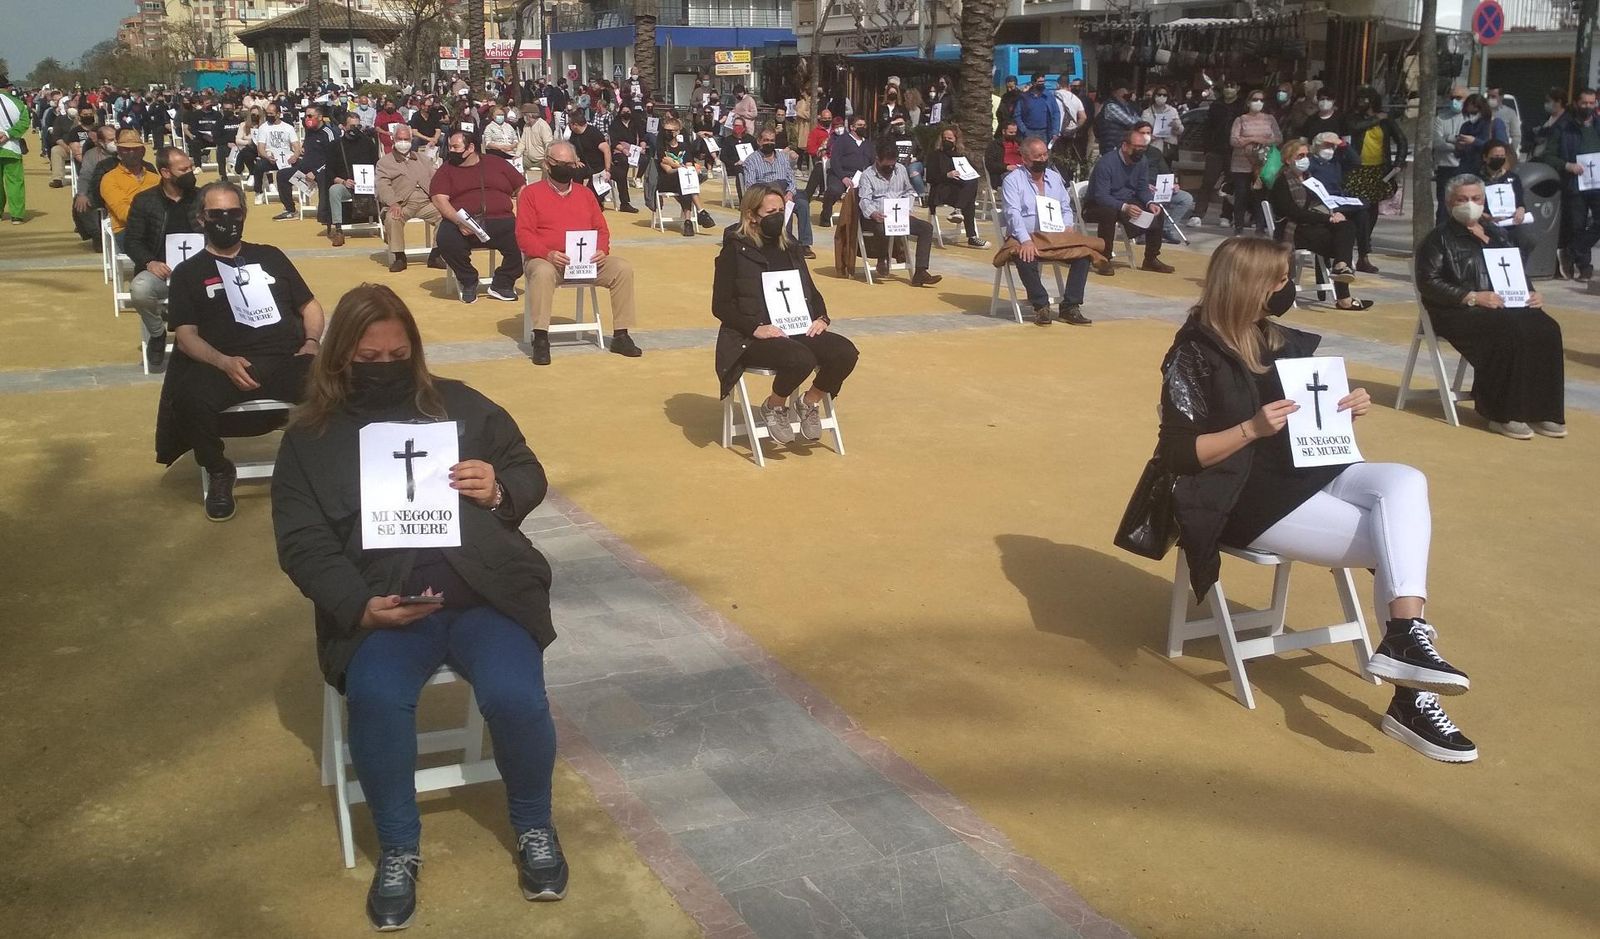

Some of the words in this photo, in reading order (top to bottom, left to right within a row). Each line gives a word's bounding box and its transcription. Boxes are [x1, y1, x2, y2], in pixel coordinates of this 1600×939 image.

[1296, 436, 1308, 446] MI
[1309, 436, 1351, 445] NEGOCIO
[1302, 447, 1315, 456] SE
[1317, 446, 1351, 456] MUERE
[372, 511, 389, 522] MI
[394, 510, 452, 521] NEGOCIO
[378, 524, 395, 535] SE
[400, 524, 448, 534] MUERE
